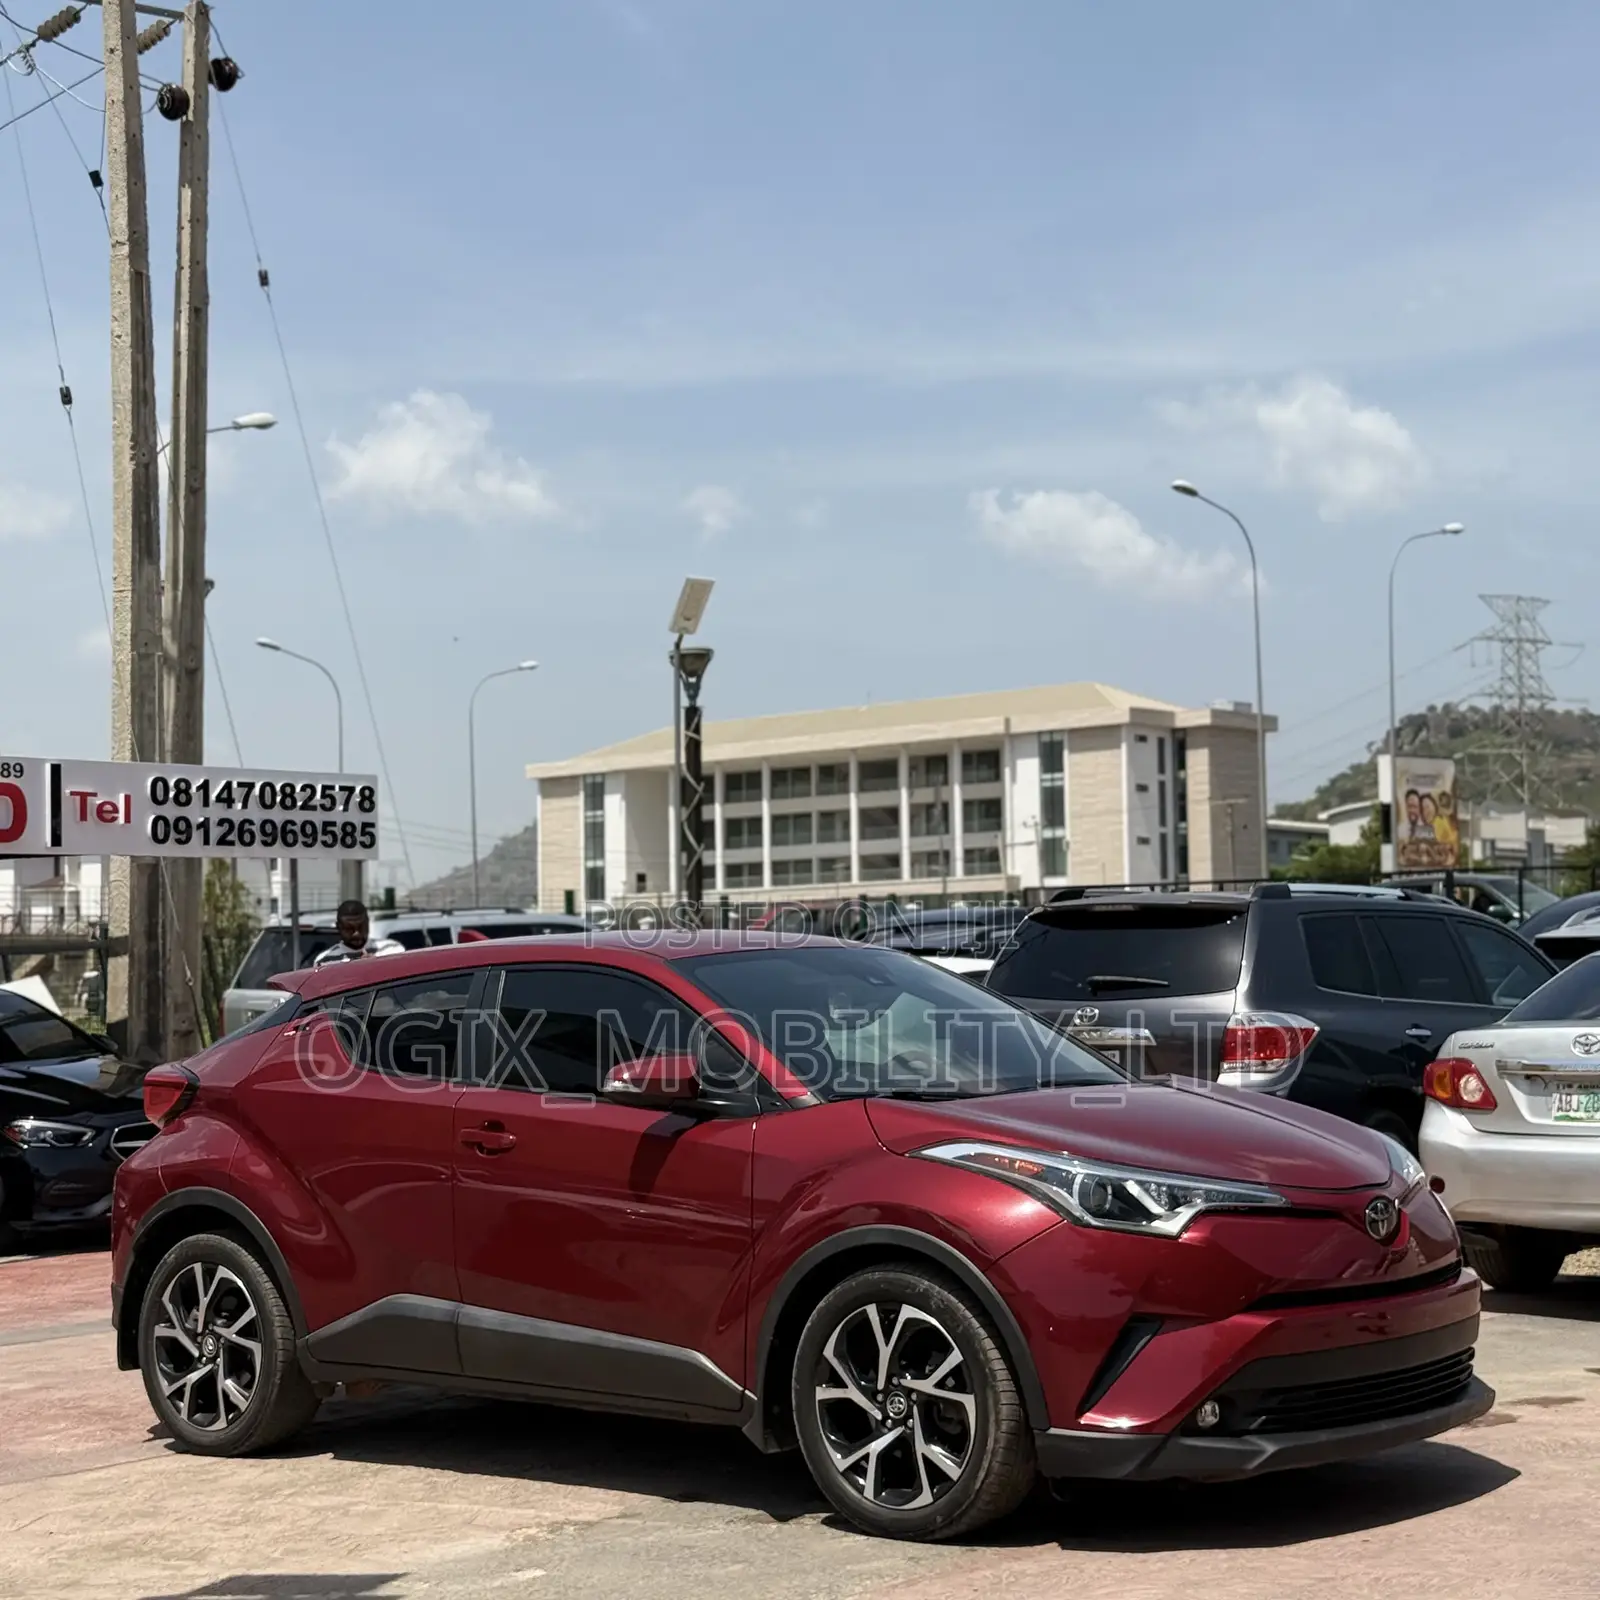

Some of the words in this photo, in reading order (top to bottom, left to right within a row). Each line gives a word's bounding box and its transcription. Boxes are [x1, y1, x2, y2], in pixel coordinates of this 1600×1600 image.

[70, 790, 131, 824] Tel
[150, 776, 376, 813] 08147082578
[150, 815, 377, 849] 09126969585
